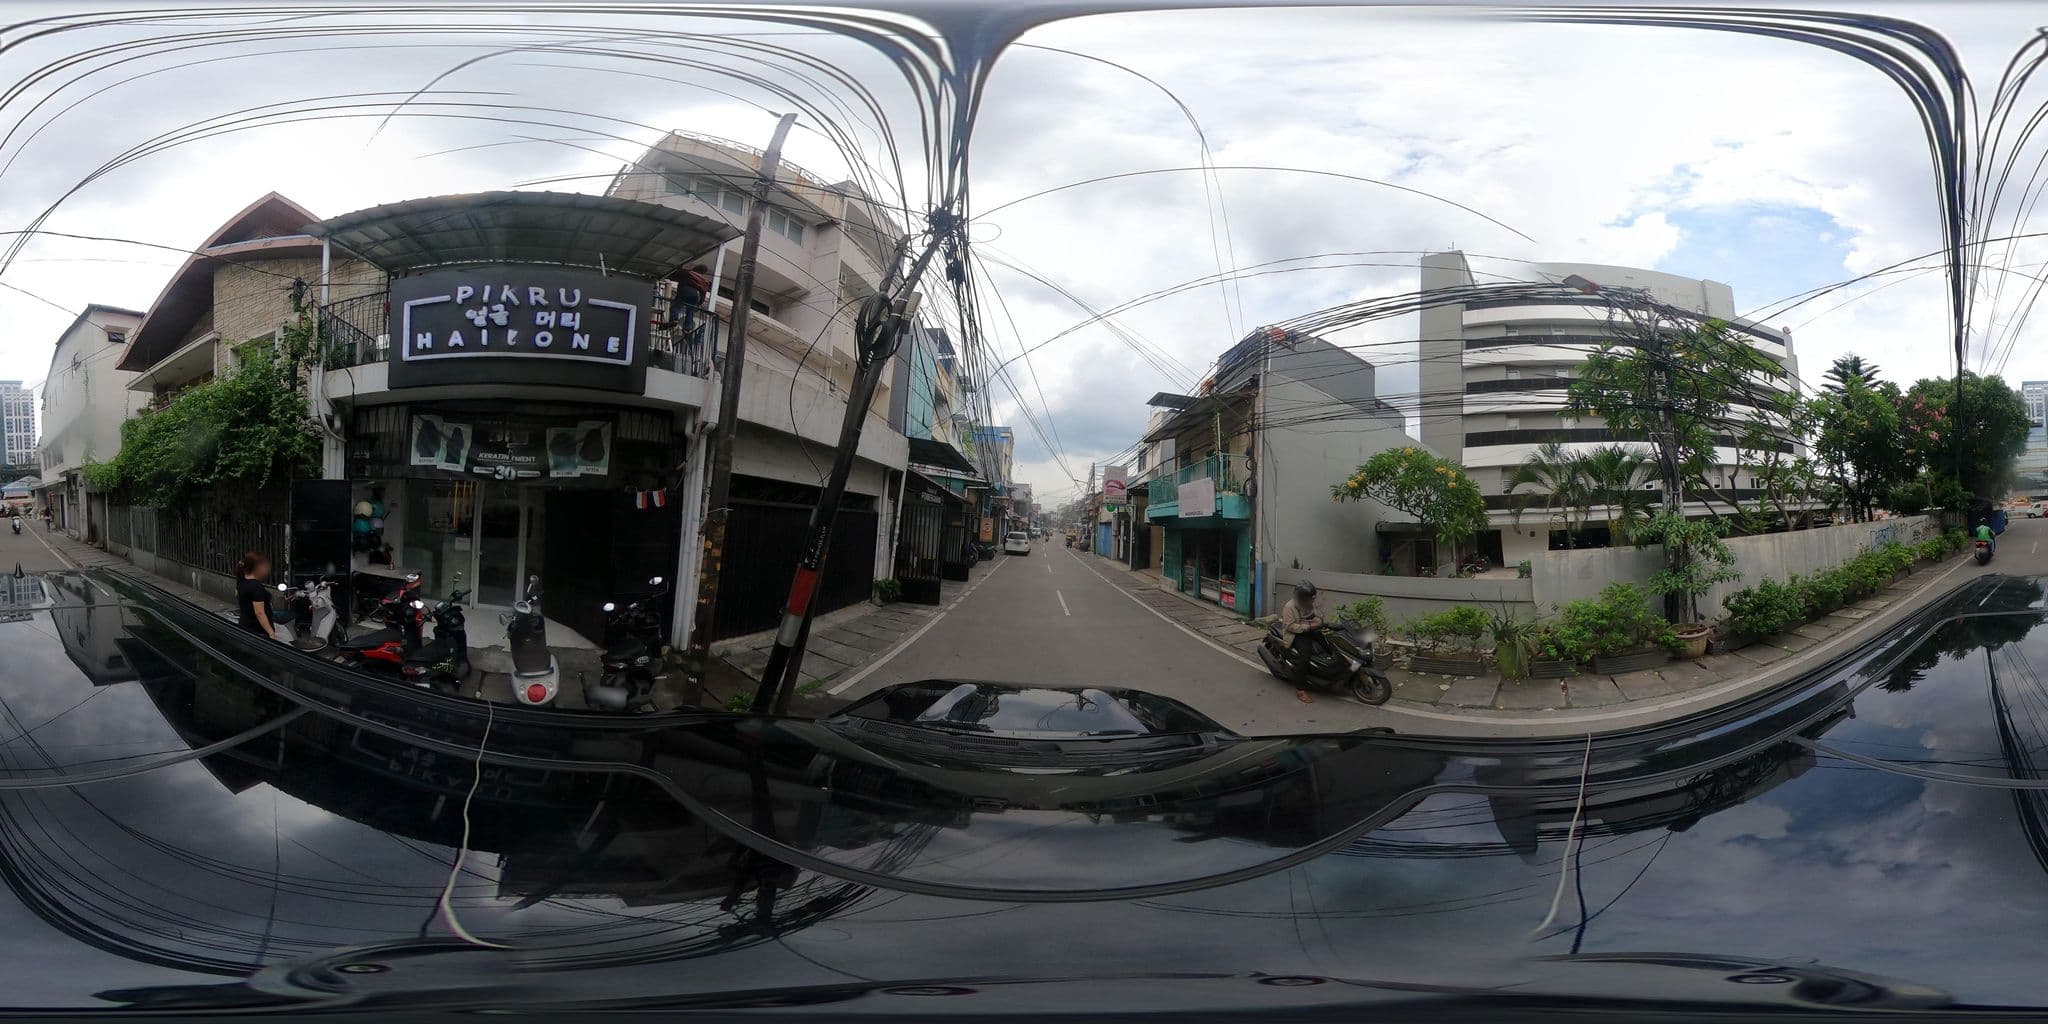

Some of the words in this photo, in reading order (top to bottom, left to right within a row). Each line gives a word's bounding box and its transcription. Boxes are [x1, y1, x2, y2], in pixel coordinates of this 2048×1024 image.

[456, 284, 581, 308] PIKRU
[535, 311, 581, 331] 머리
[478, 452, 509, 461] KERATIN
